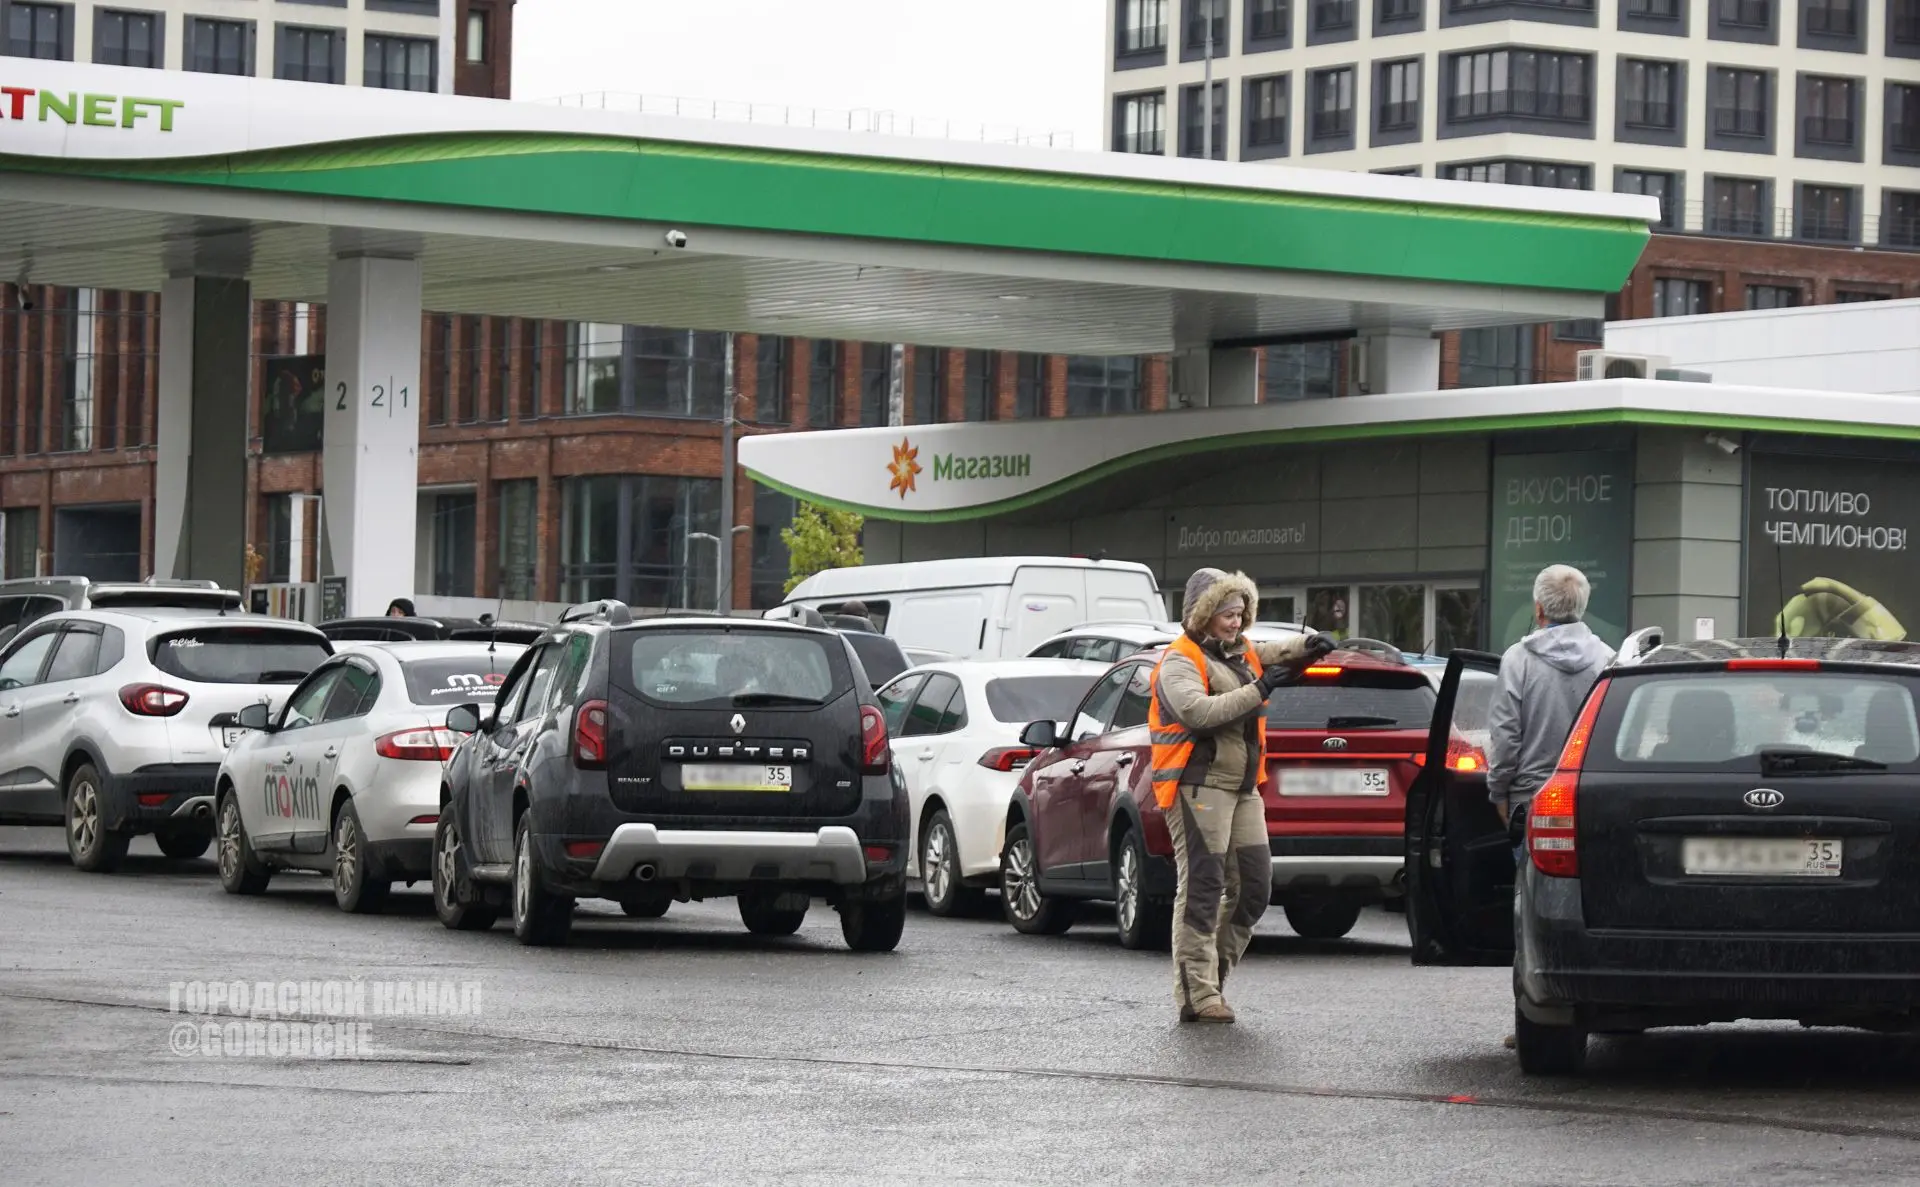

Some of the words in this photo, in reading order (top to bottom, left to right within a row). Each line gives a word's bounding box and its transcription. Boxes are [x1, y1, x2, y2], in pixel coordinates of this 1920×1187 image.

[0, 86, 185, 132] TNEFT
[336, 381, 347, 411] 2
[933, 452, 1031, 481] Магазин
[1507, 475, 1613, 505] ВКУСНОЕ
[1765, 487, 1870, 515] ТОПЛИВО
[1179, 525, 1220, 552] Добро
[1223, 522, 1306, 546] пожаловать!
[1505, 514, 1572, 550] ДЕЛО!
[1765, 521, 1907, 550] ЧЕМПИОНОВ!
[669, 746, 807, 758] DUSTER
[768, 767, 785, 781] 35
[1363, 773, 1380, 786] 35
[1750, 793, 1777, 803] KIA
[1807, 861, 1825, 869] RUS
[1809, 842, 1833, 861] 35
